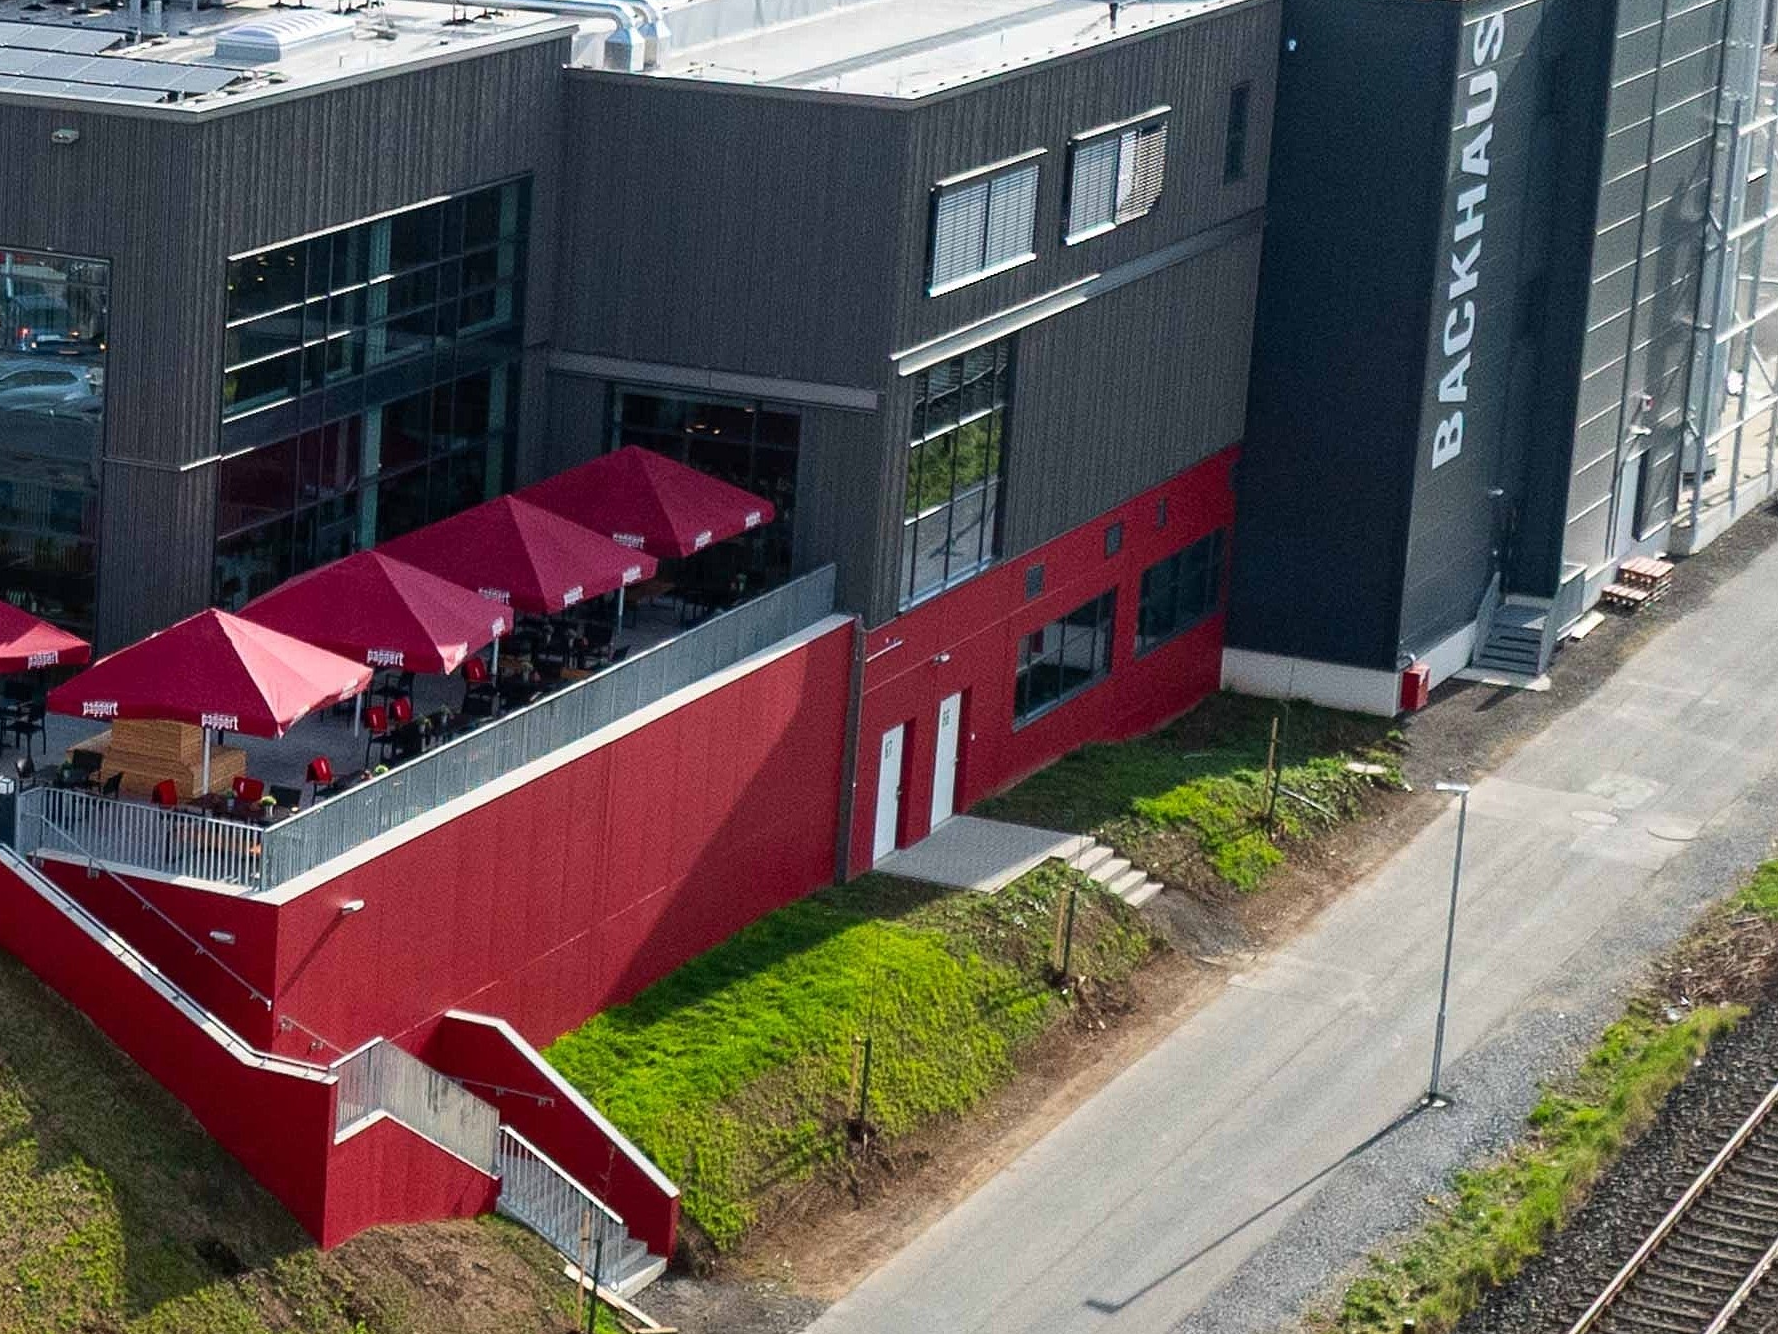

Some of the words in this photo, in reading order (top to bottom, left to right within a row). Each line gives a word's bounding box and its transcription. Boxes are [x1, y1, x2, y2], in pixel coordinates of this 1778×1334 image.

[1432, 13, 1506, 470] BACKHAUS
[367, 649, 404, 667] pappert
[82, 701, 119, 718] pappert
[201, 712, 239, 731] pappert
